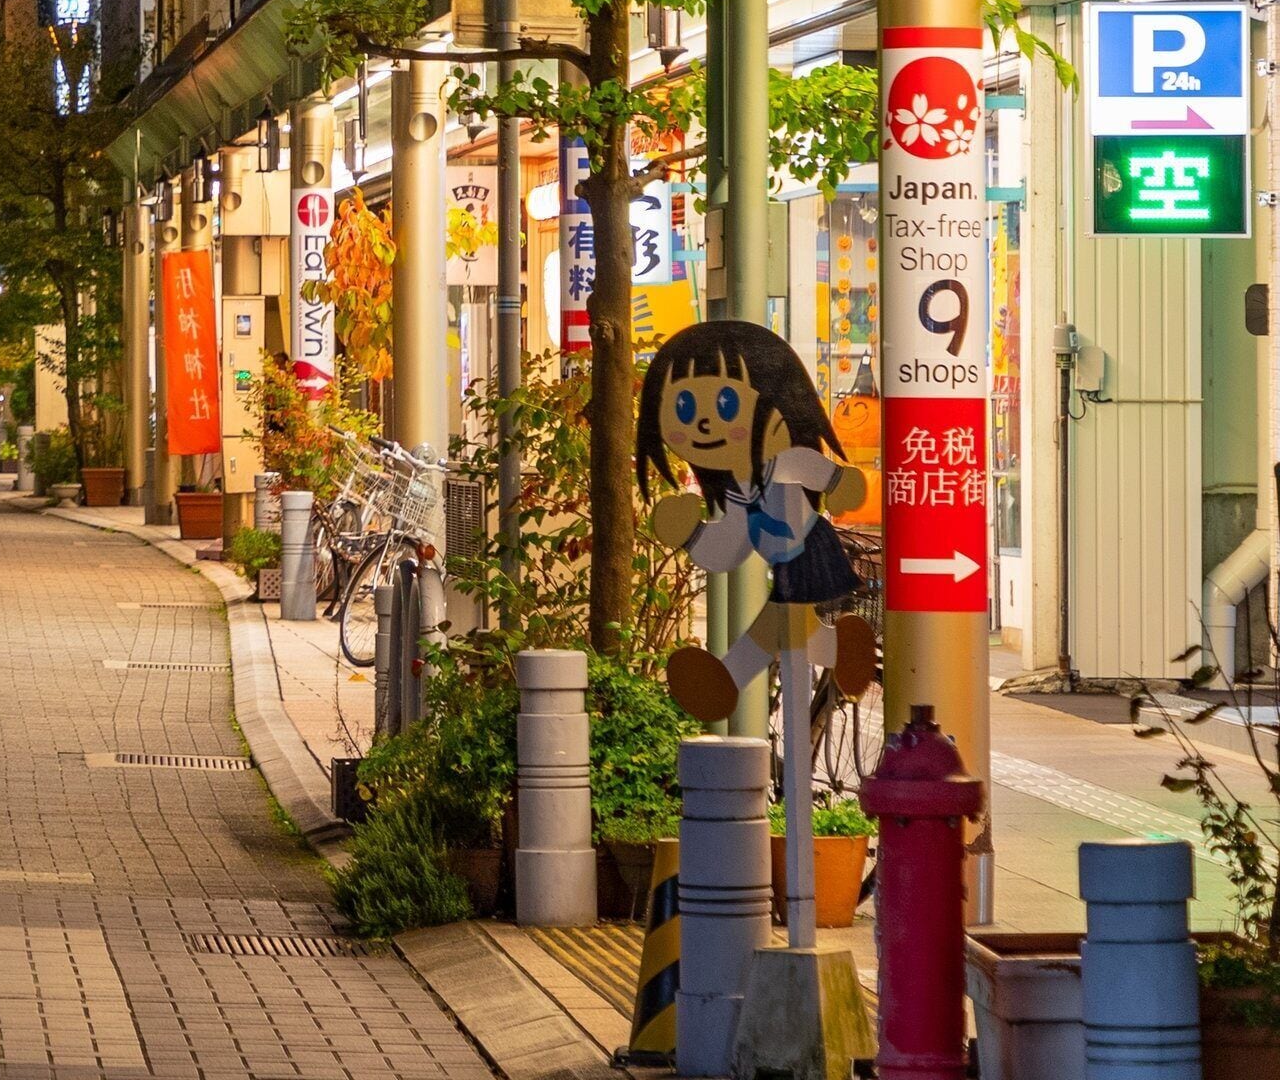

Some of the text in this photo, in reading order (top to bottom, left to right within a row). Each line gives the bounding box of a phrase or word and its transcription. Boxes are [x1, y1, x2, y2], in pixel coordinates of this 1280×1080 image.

[1133, 14, 1206, 93] P
[1162, 71, 1201, 91] 24h
[1129, 151, 1211, 219] 空
[885, 214, 981, 238] Tax-free
[900, 247, 968, 277] Shop
[918, 279, 970, 358] 9
[899, 358, 979, 389] shops
[901, 426, 978, 466] 免税
[887, 468, 986, 507] 商店街
